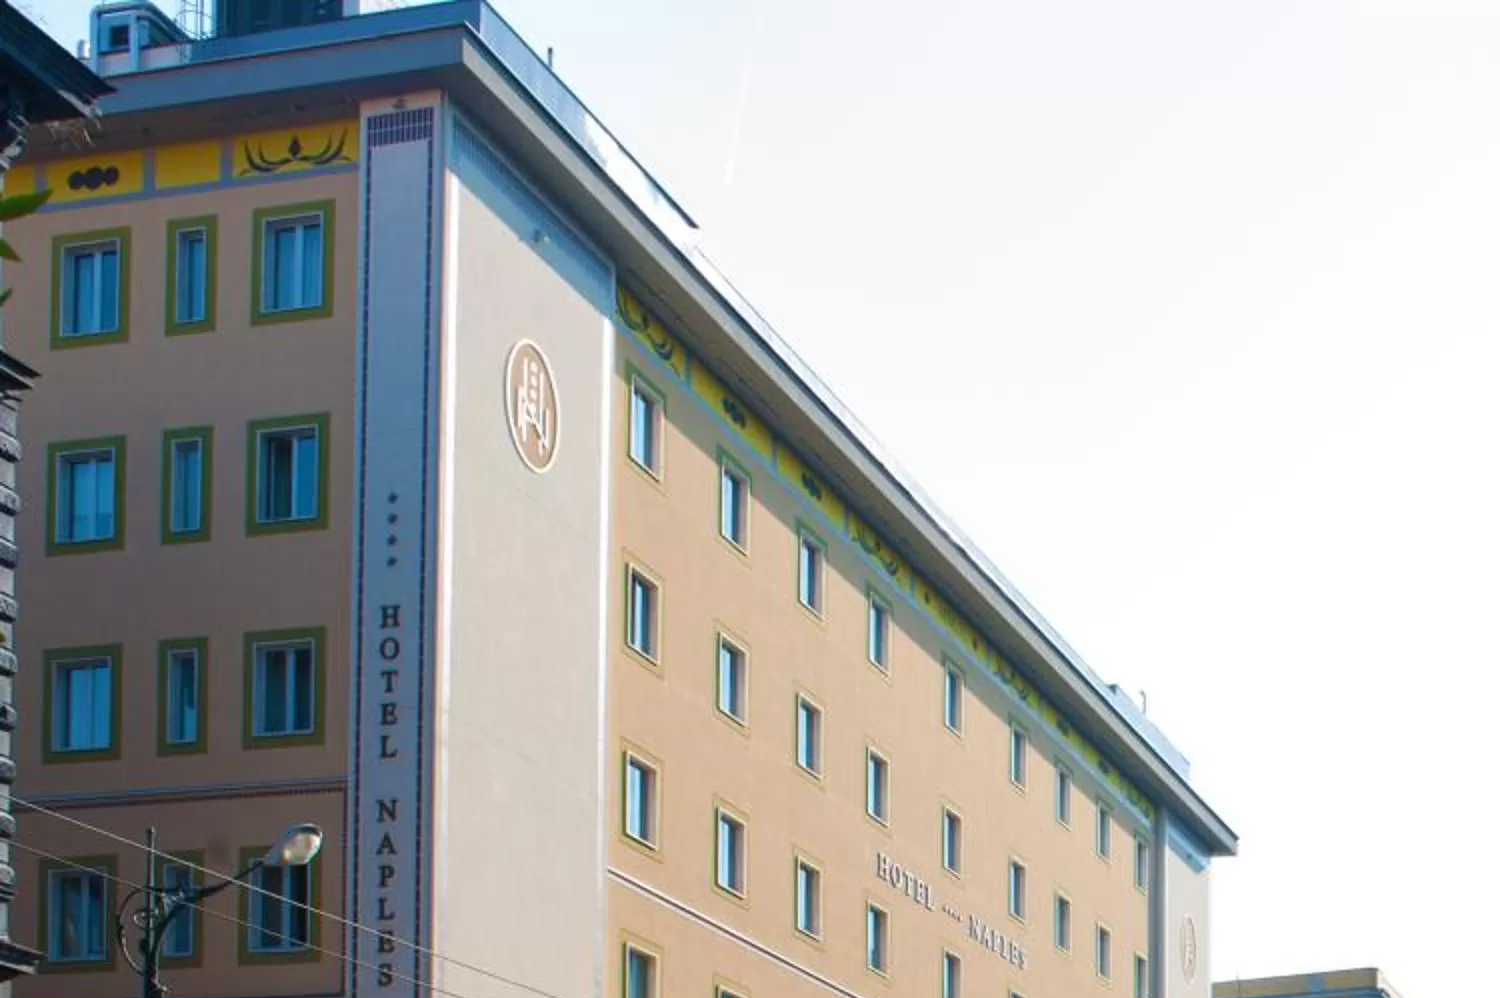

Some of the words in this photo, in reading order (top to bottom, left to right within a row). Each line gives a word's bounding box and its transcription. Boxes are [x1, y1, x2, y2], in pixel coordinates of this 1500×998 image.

[378, 605, 401, 760] HOTEL
[375, 799, 399, 988] NAPLES
[876, 852, 935, 912] HOTEL
[968, 914, 1027, 970] NAPLES
